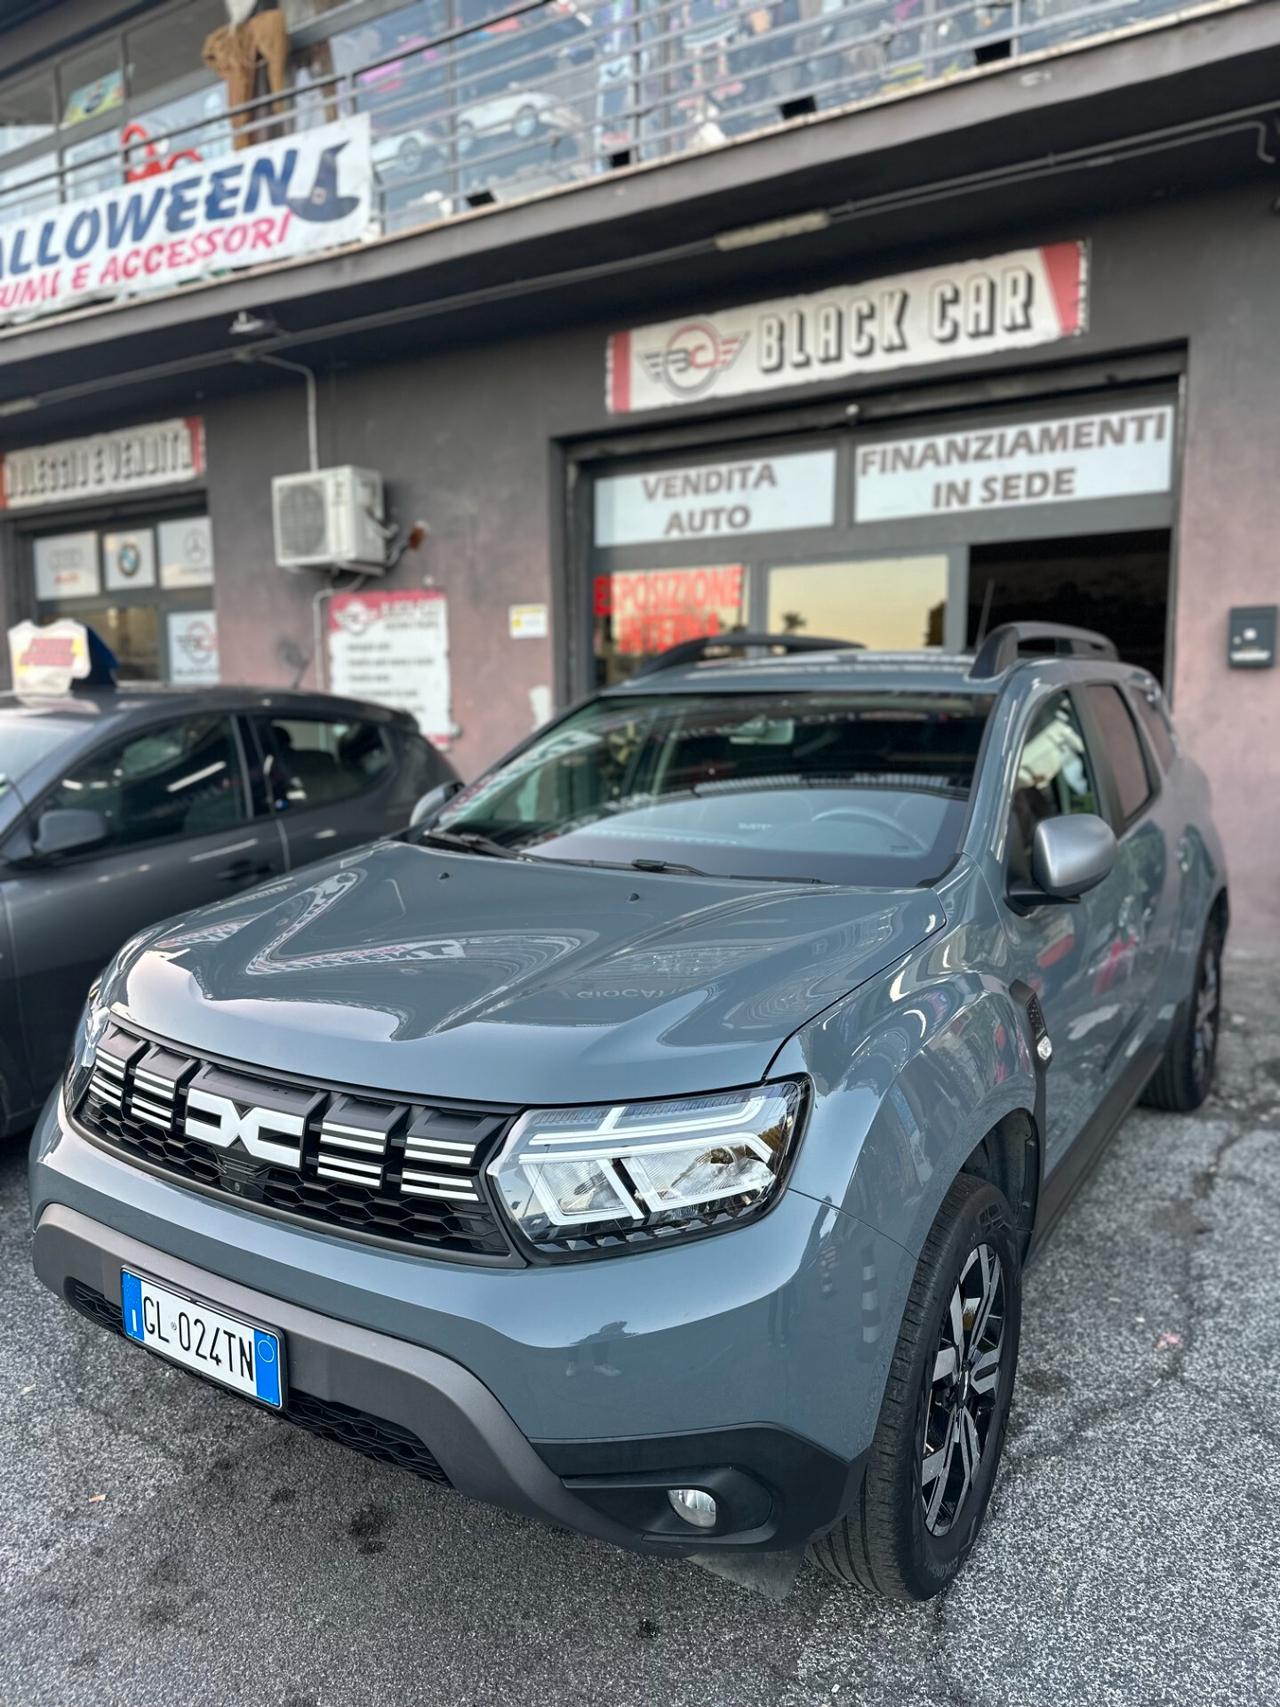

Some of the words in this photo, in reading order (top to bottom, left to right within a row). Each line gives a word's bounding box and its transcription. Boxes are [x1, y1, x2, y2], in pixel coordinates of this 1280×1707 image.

[0, 149, 298, 279] LLOWEEN
[71, 261, 91, 290] E
[100, 210, 294, 286] ACCESSORI
[757, 288, 910, 374] BLACK
[928, 266, 1037, 342] CAR
[859, 410, 1167, 477] FINANZIAMENTI
[641, 462, 777, 501] VENDITA
[932, 480, 973, 510] IN
[980, 468, 1076, 504] SEDE
[664, 504, 751, 536] AUTO
